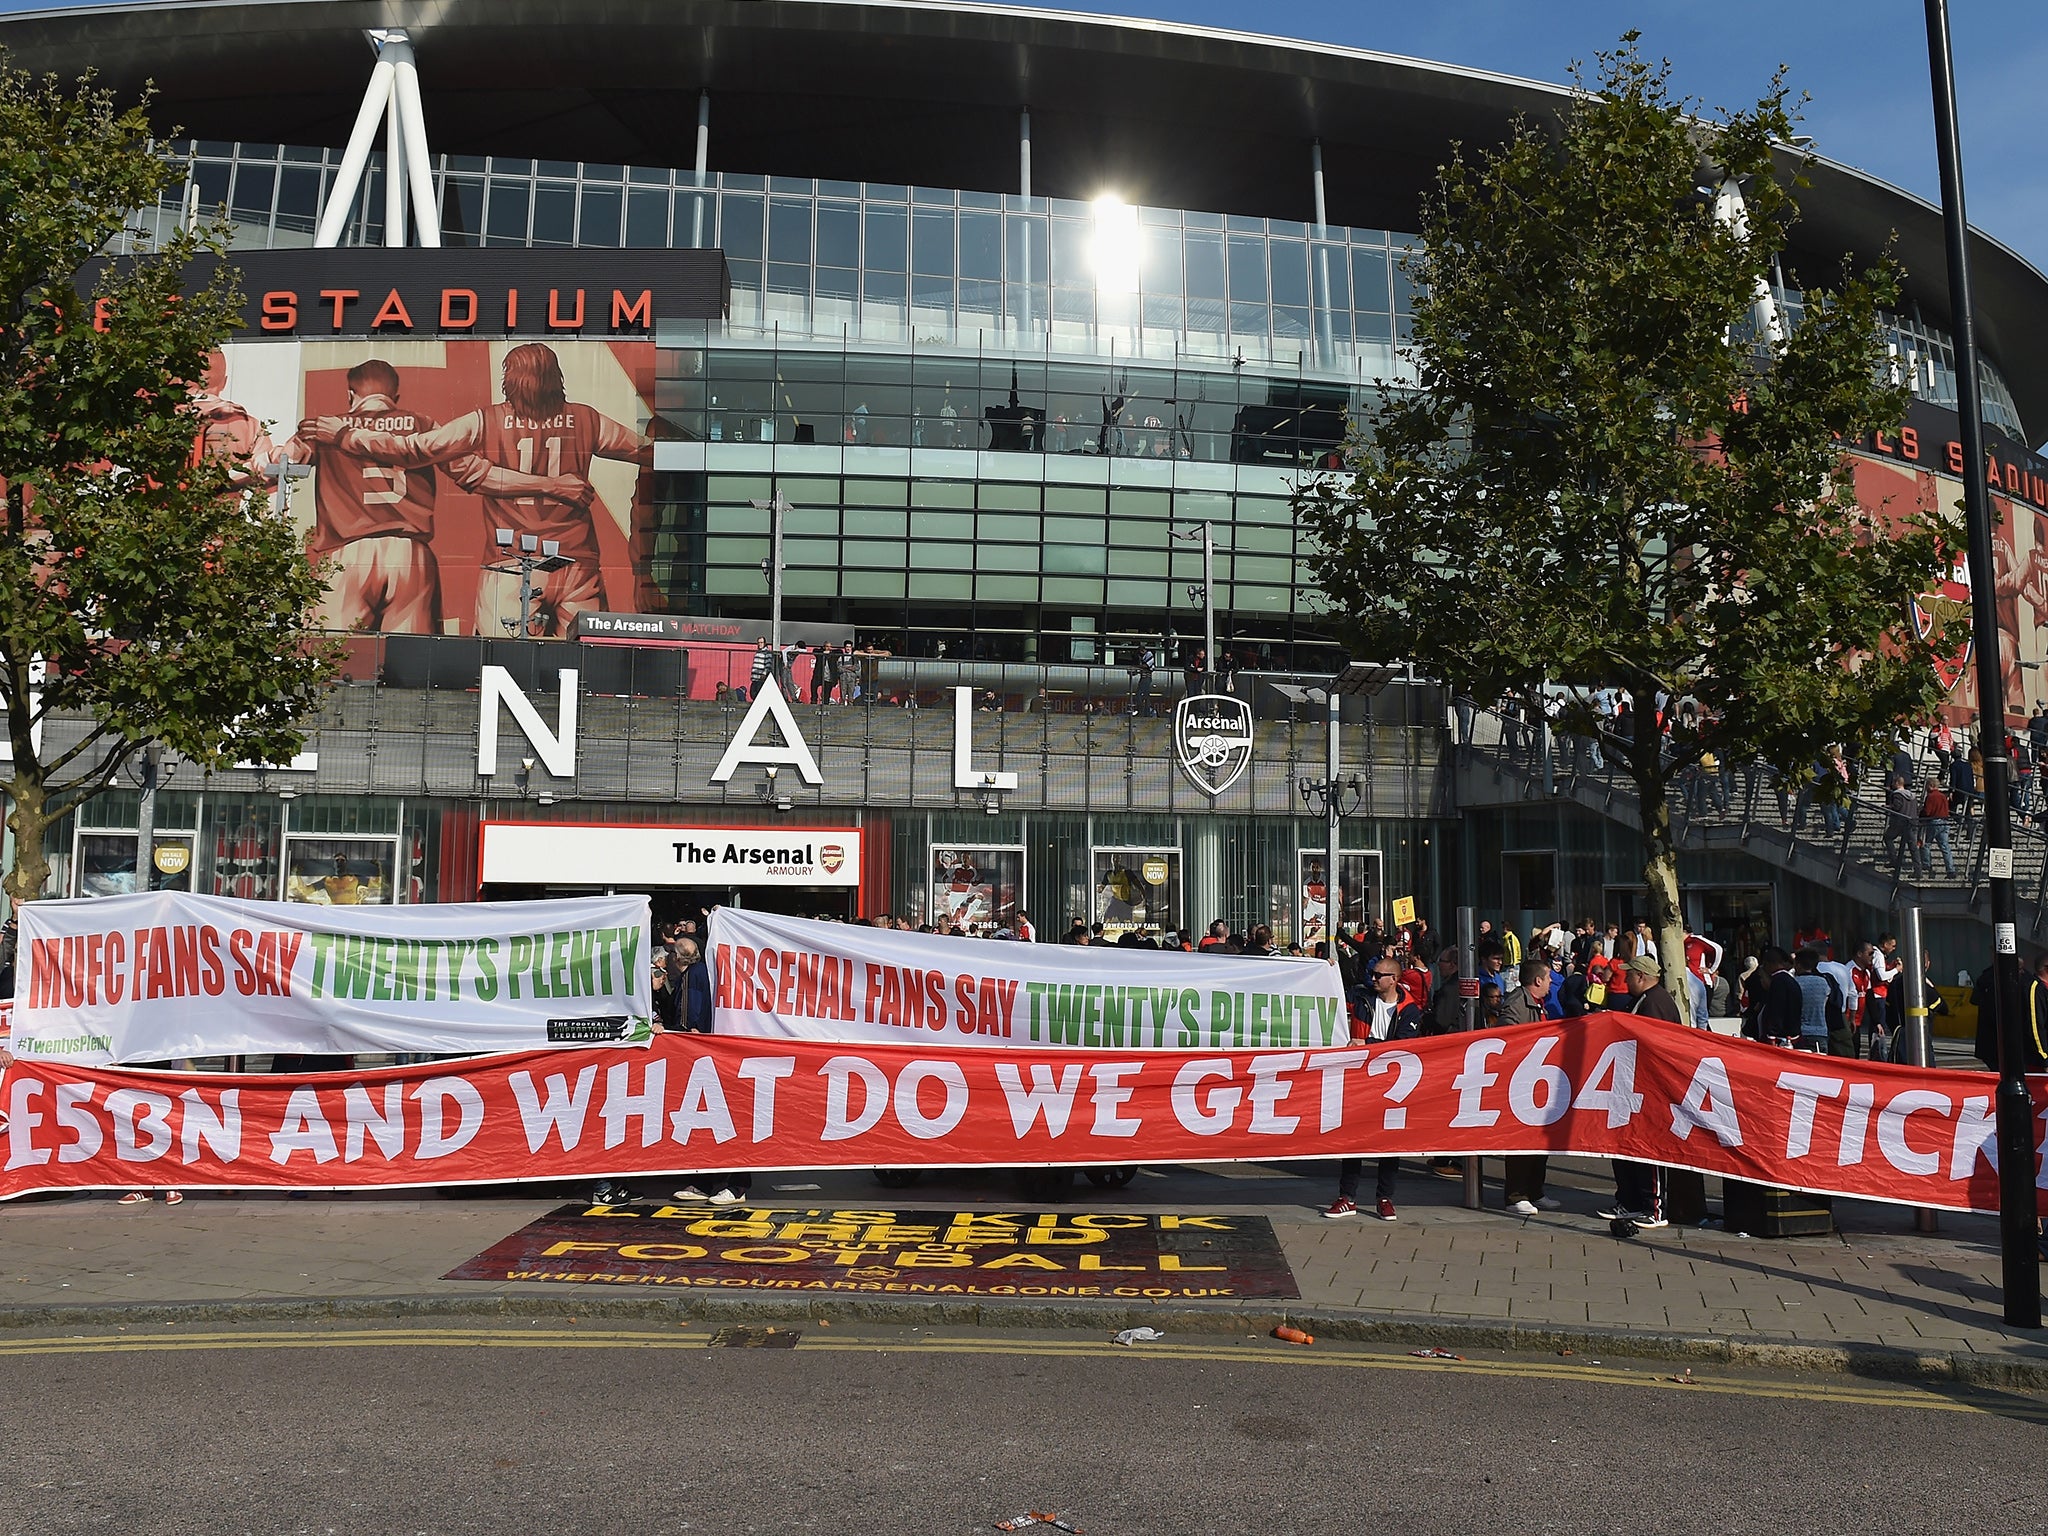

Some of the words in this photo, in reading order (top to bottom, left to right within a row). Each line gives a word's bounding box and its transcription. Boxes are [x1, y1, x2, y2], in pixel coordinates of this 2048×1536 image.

[260, 287, 652, 330] STADIUM
[1945, 441, 2048, 506] SADIU
[586, 617, 611, 631] The
[613, 618, 664, 633] Arsenal
[681, 622, 741, 636] MATCHDAY
[1185, 714, 1244, 731] Arsenal
[159, 857, 185, 867] NOW
[672, 842, 716, 864] The
[722, 843, 814, 865] Arsenal
[766, 866, 814, 876] ARMOURY
[1146, 871, 1165, 880] NOW
[28, 930, 125, 1010] MUFC
[131, 924, 226, 1002] FANS
[229, 928, 304, 998] SAY
[310, 931, 500, 1002] TWENTY'S
[508, 925, 641, 1000] PLENTY
[714, 942, 857, 1022] ARSENAL
[864, 962, 948, 1032] FANS
[955, 973, 1020, 1039] SAY
[1025, 981, 1201, 1048] TWENTY'S
[1210, 990, 1339, 1047] PLENTY
[16, 1033, 113, 1055] #TwentysPlenty
[3, 1077, 240, 1172] £5BN
[268, 1076, 485, 1166] AND
[507, 1055, 796, 1155] WHAT
[818, 1055, 970, 1141] DO
[994, 1061, 1146, 1140] WE
[1170, 1049, 1424, 1136] GET?
[1448, 1036, 1644, 1130] £64
[1669, 1056, 1744, 1148] A
[1775, 1071, 2048, 1192] TICK
[581, 1205, 898, 1226] LET'S
[951, 1212, 1238, 1231] KICK
[684, 1218, 1111, 1245] GREED
[540, 1240, 1228, 1272] FOOTBALL
[799, 1240, 900, 1251] OUT
[917, 1242, 984, 1253] OF
[504, 1270, 1236, 1298] WHEREHASOURARSENALGONE.CO.UK
